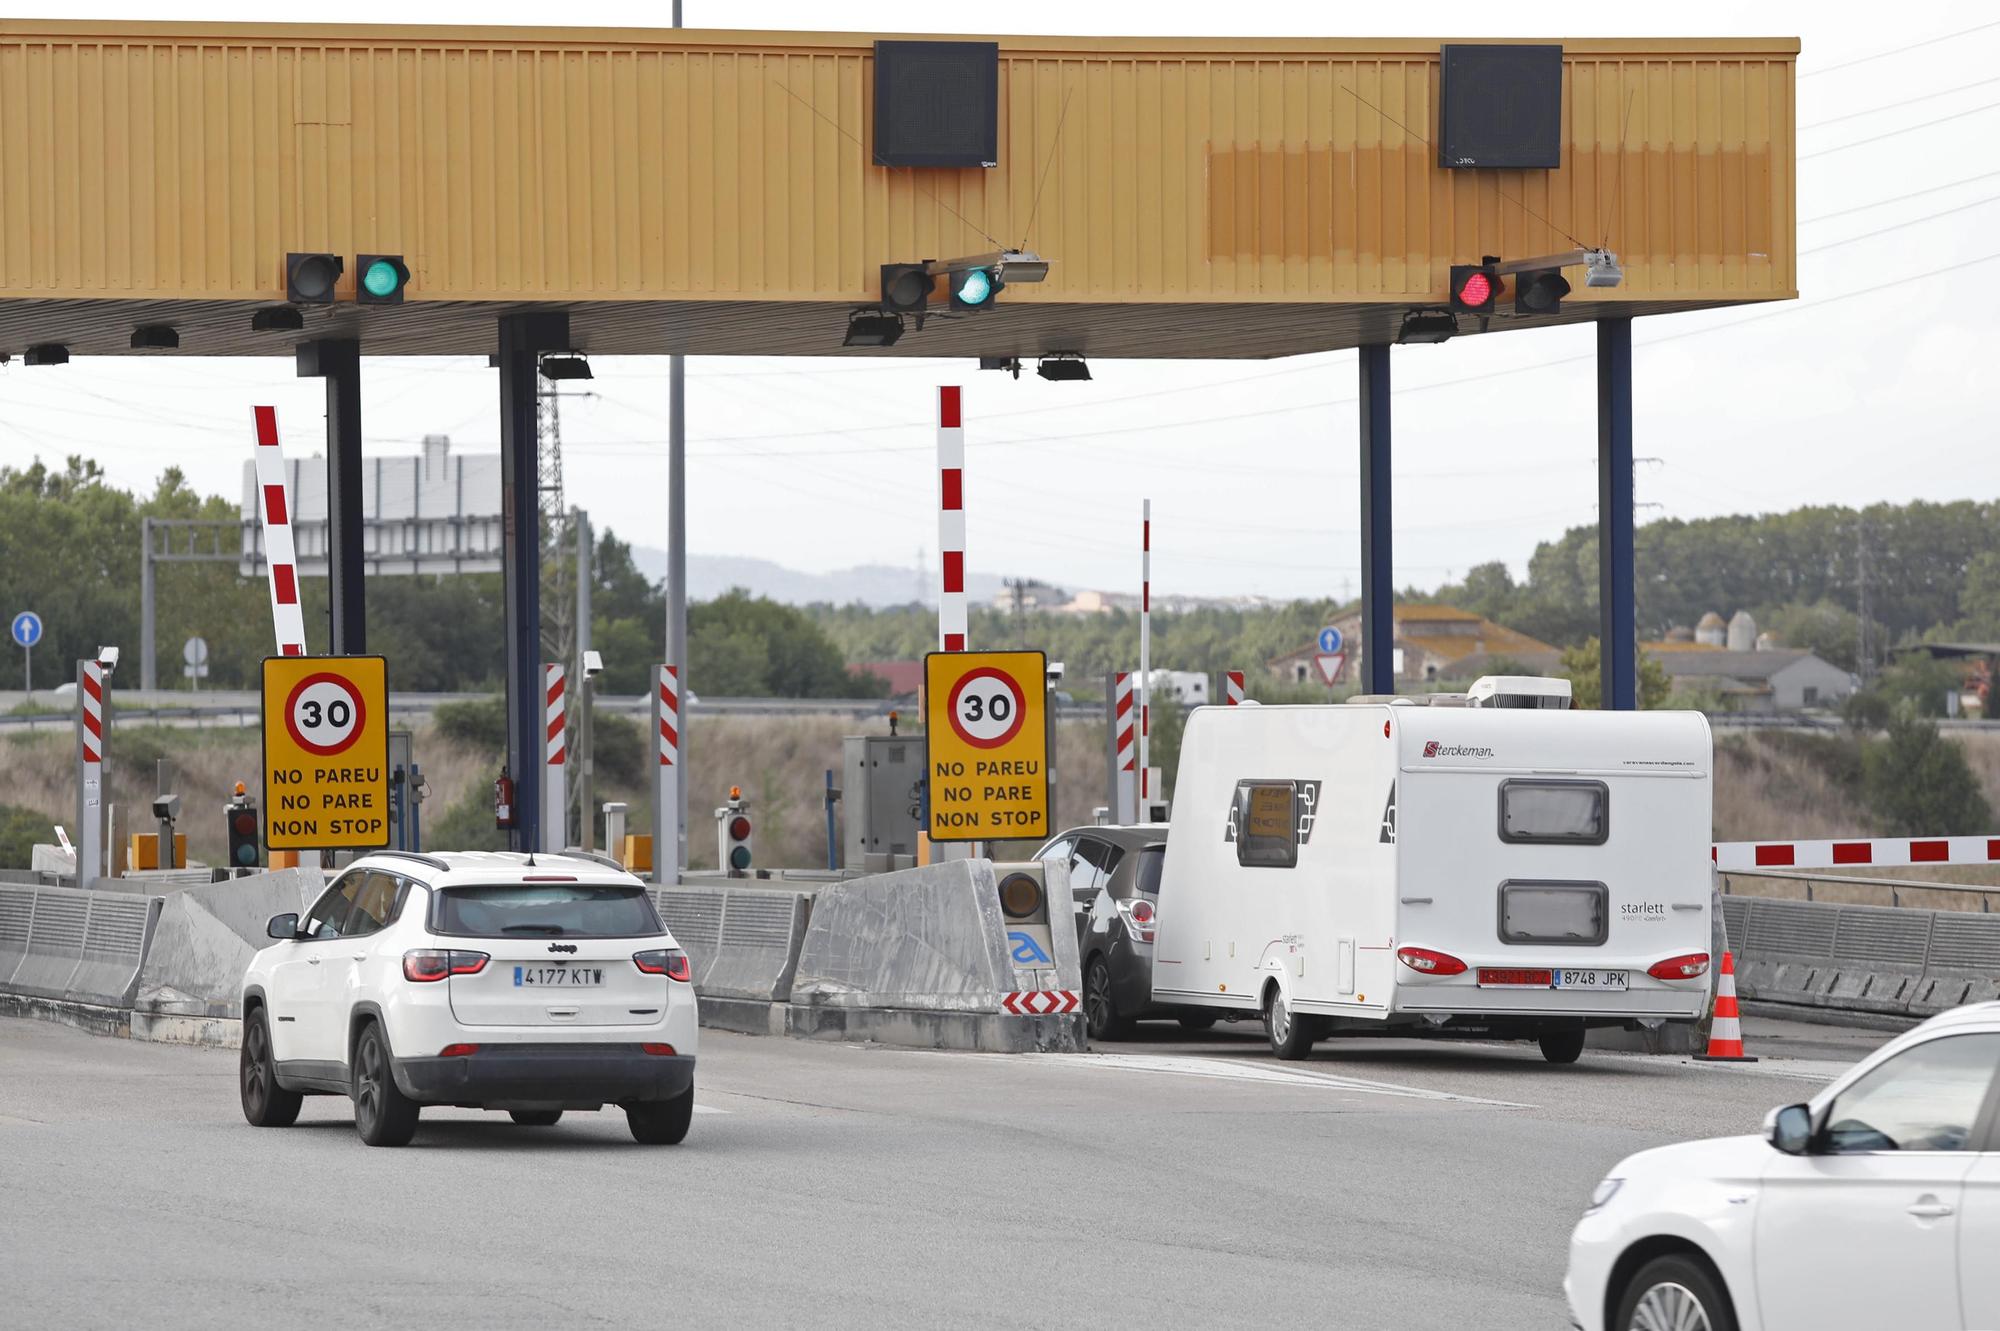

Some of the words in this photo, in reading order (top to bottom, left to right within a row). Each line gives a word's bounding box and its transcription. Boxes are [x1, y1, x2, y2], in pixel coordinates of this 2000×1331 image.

[301, 700, 350, 728] 30
[964, 694, 1011, 722] 30
[273, 769, 303, 784] NO
[314, 767, 379, 784] PAREU
[936, 762, 965, 777] NO
[976, 760, 1038, 776] PAREU
[281, 795, 310, 810] NO
[322, 793, 373, 809] PARE
[944, 787, 972, 802] NO
[984, 785, 1032, 801] PARE
[272, 820, 317, 836] NON
[329, 818, 382, 834] STOP
[936, 812, 979, 827] NON
[991, 811, 1041, 826] STOP
[1621, 901, 1664, 914] starlett
[547, 942, 578, 955] Jeep
[525, 968, 567, 985] 4177
[572, 968, 603, 985] KTW
[1564, 971, 1596, 985] 8748
[1602, 972, 1626, 986] JPK
